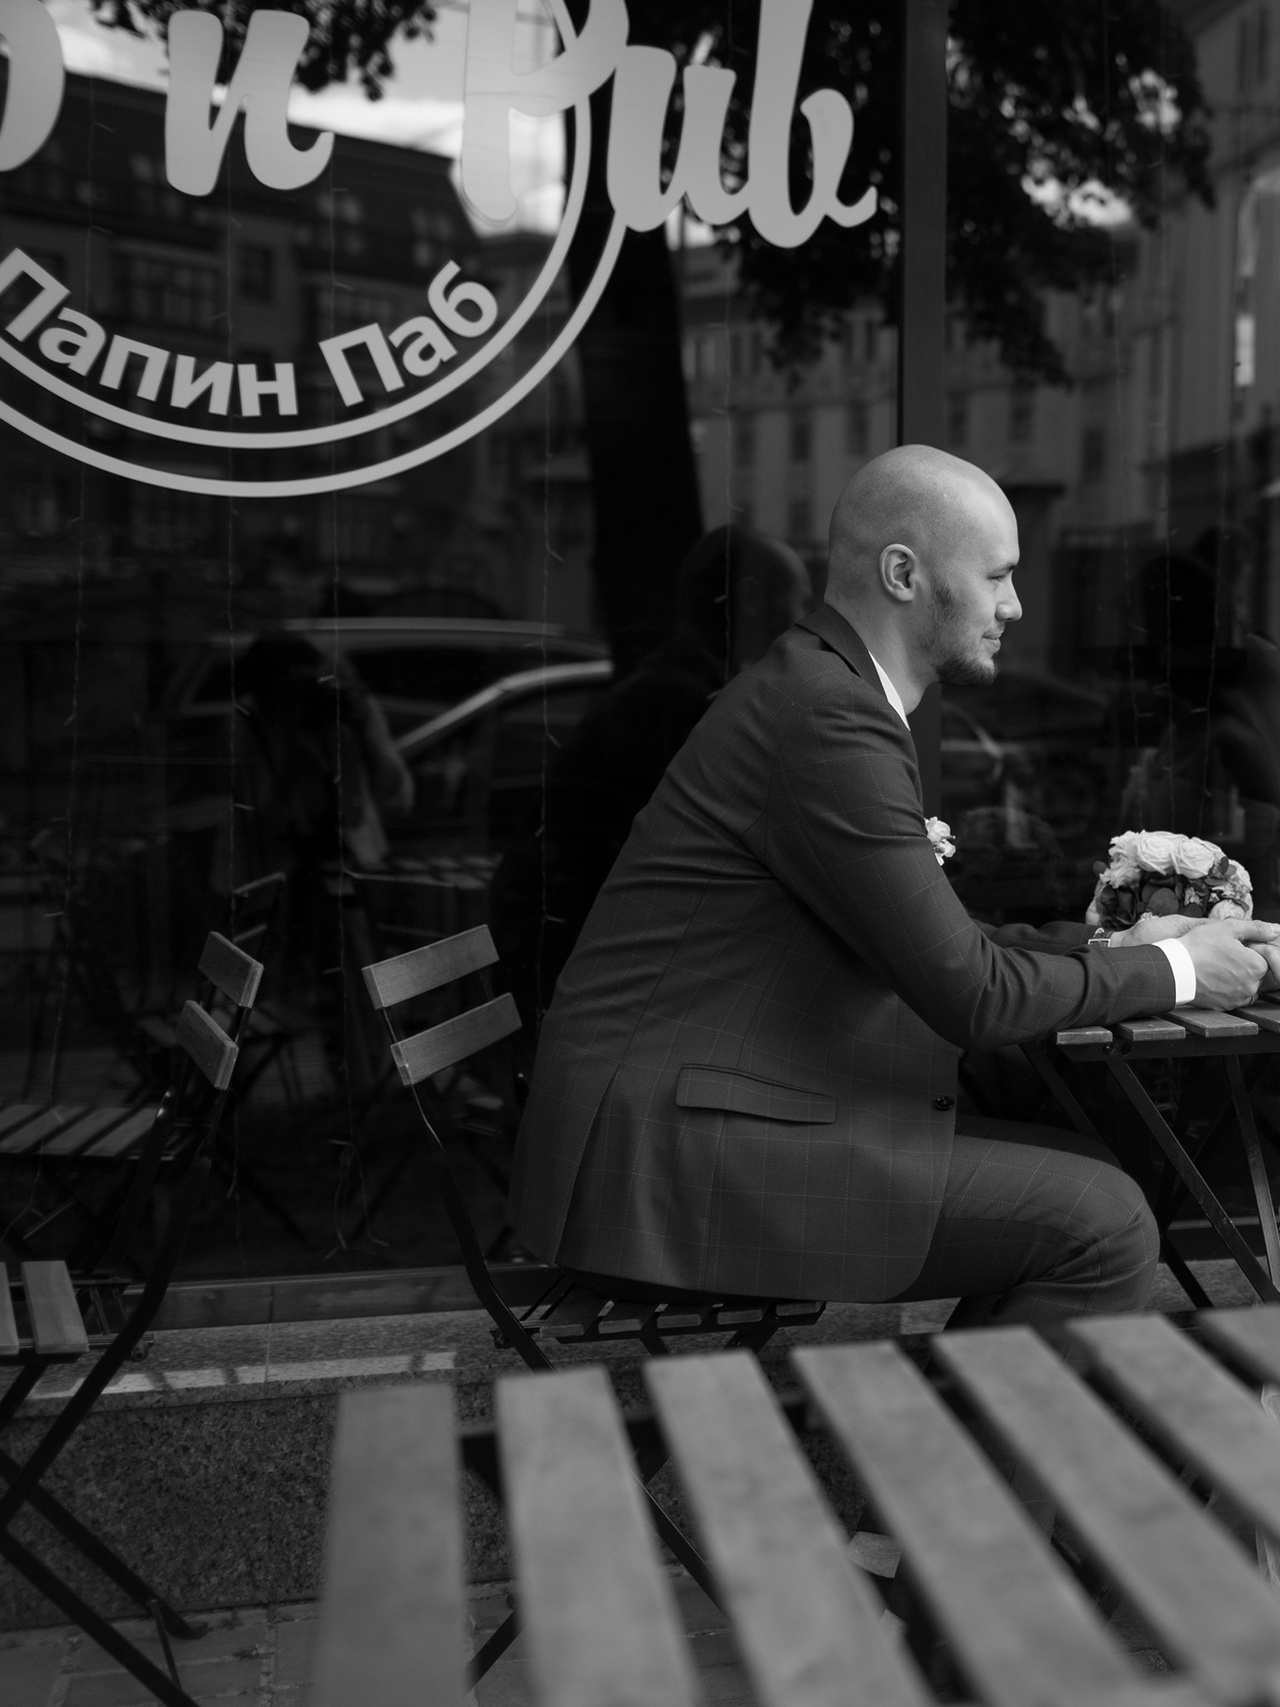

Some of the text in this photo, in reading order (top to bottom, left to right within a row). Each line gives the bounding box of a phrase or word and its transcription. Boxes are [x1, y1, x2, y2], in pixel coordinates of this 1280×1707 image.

[460, 0, 878, 249] Pub
[0, 247, 499, 417] Папин Паб
